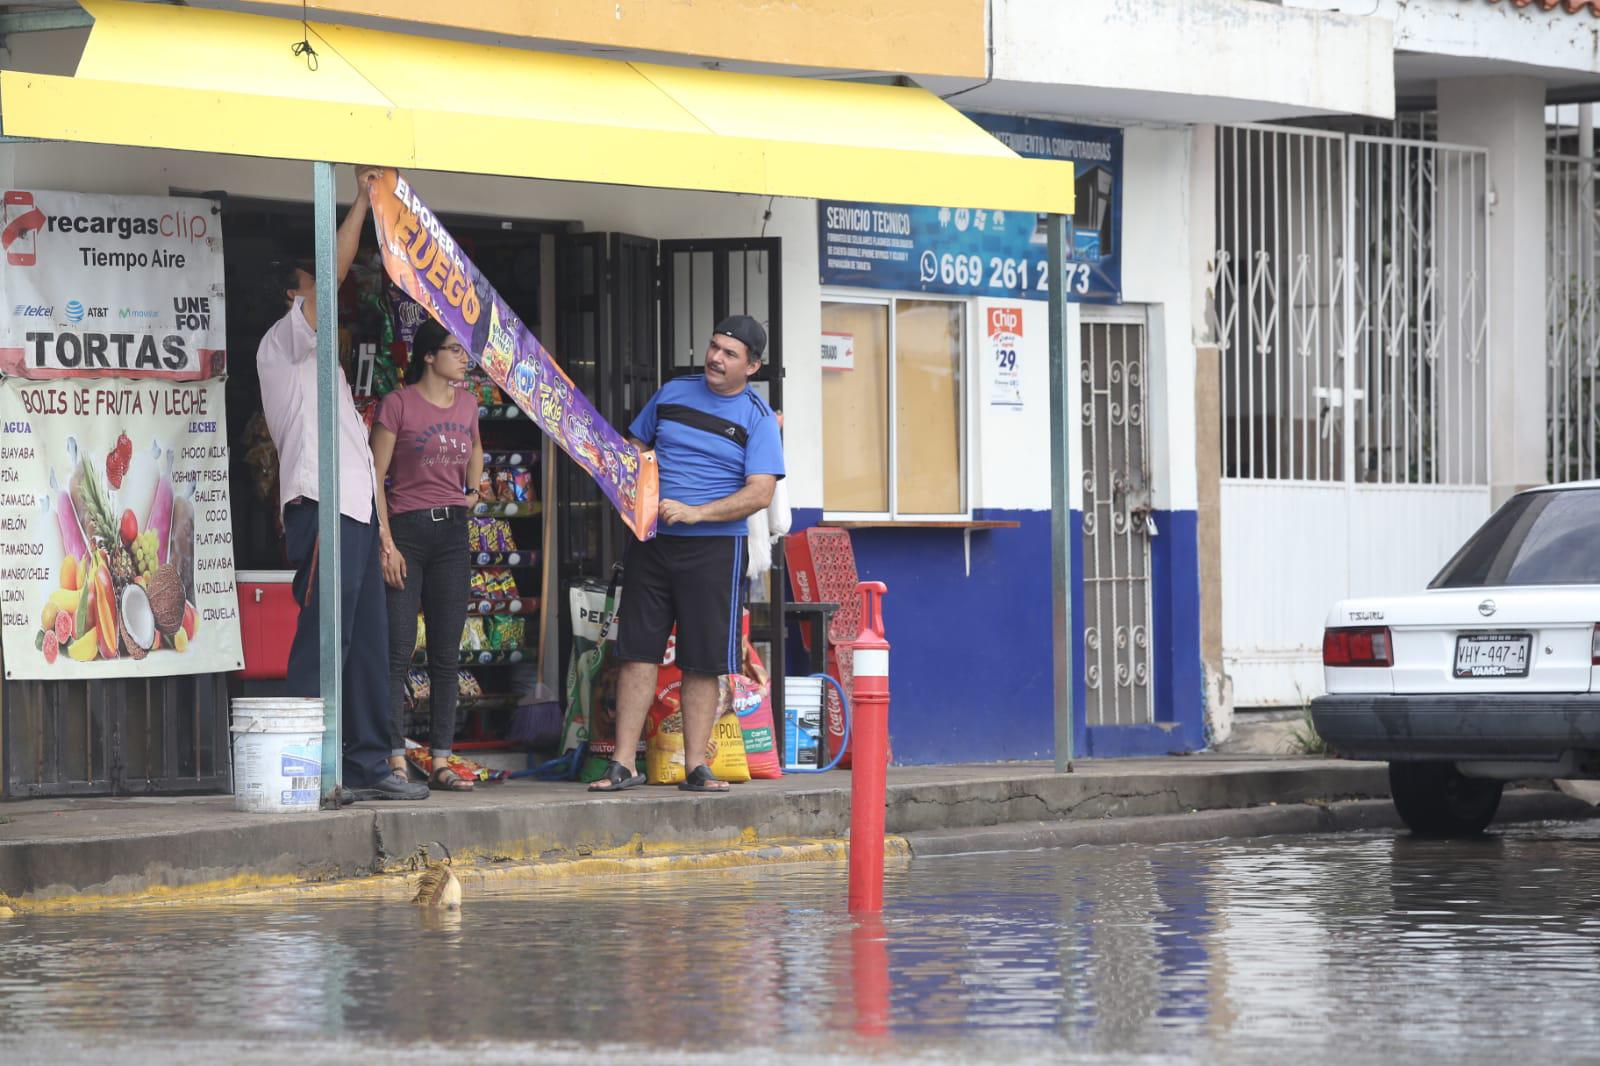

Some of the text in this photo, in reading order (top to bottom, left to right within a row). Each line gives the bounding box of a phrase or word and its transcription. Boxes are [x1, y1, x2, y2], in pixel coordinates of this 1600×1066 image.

[1053, 138, 1112, 161] COMPUTADORAS
[394, 176, 411, 208] EL
[412, 195, 454, 258] PODER
[827, 206, 910, 236] SERVICIO TECNICO
[79, 247, 186, 271] Tiempo Aire
[395, 206, 481, 325] FUEGO
[940, 253, 983, 287] 669
[989, 256, 1028, 290] 261
[1036, 260, 1091, 294] 273
[23, 305, 54, 317] telcel
[173, 297, 210, 314] UNE
[87, 307, 109, 318] AT&T
[175, 314, 210, 331] FON
[992, 309, 1018, 332] Chip
[26, 332, 188, 369] TORTAS
[21, 389, 207, 416] BOLIS DE FRUTA Y LECHE
[3, 422, 31, 433] AGUA
[188, 422, 216, 433] LECHE
[0, 447, 34, 459] GUAYABA
[181, 446, 226, 459] CHOCO MILK
[1, 467, 18, 482] PIÑA
[203, 470, 227, 482] FRESA
[1, 494, 35, 506] JAMAICA
[194, 490, 226, 502] GALLETA
[206, 509, 228, 521] COCO
[0, 514, 26, 530] MELÓN
[196, 532, 232, 545] PLATANO
[0, 543, 44, 555] TAMARINDO
[198, 557, 233, 570] GUAYABA
[0, 568, 49, 580] MANGO/CHILE
[196, 581, 234, 594] VAINILLA
[3, 614, 28, 625] CIRUELA
[203, 608, 236, 620] CIRUELA
[1349, 611, 1384, 620] TSURU
[1459, 645, 1525, 663] VHY-447-A
[1471, 666, 1505, 676] VAMSA
[719, 723, 743, 739] POLL
